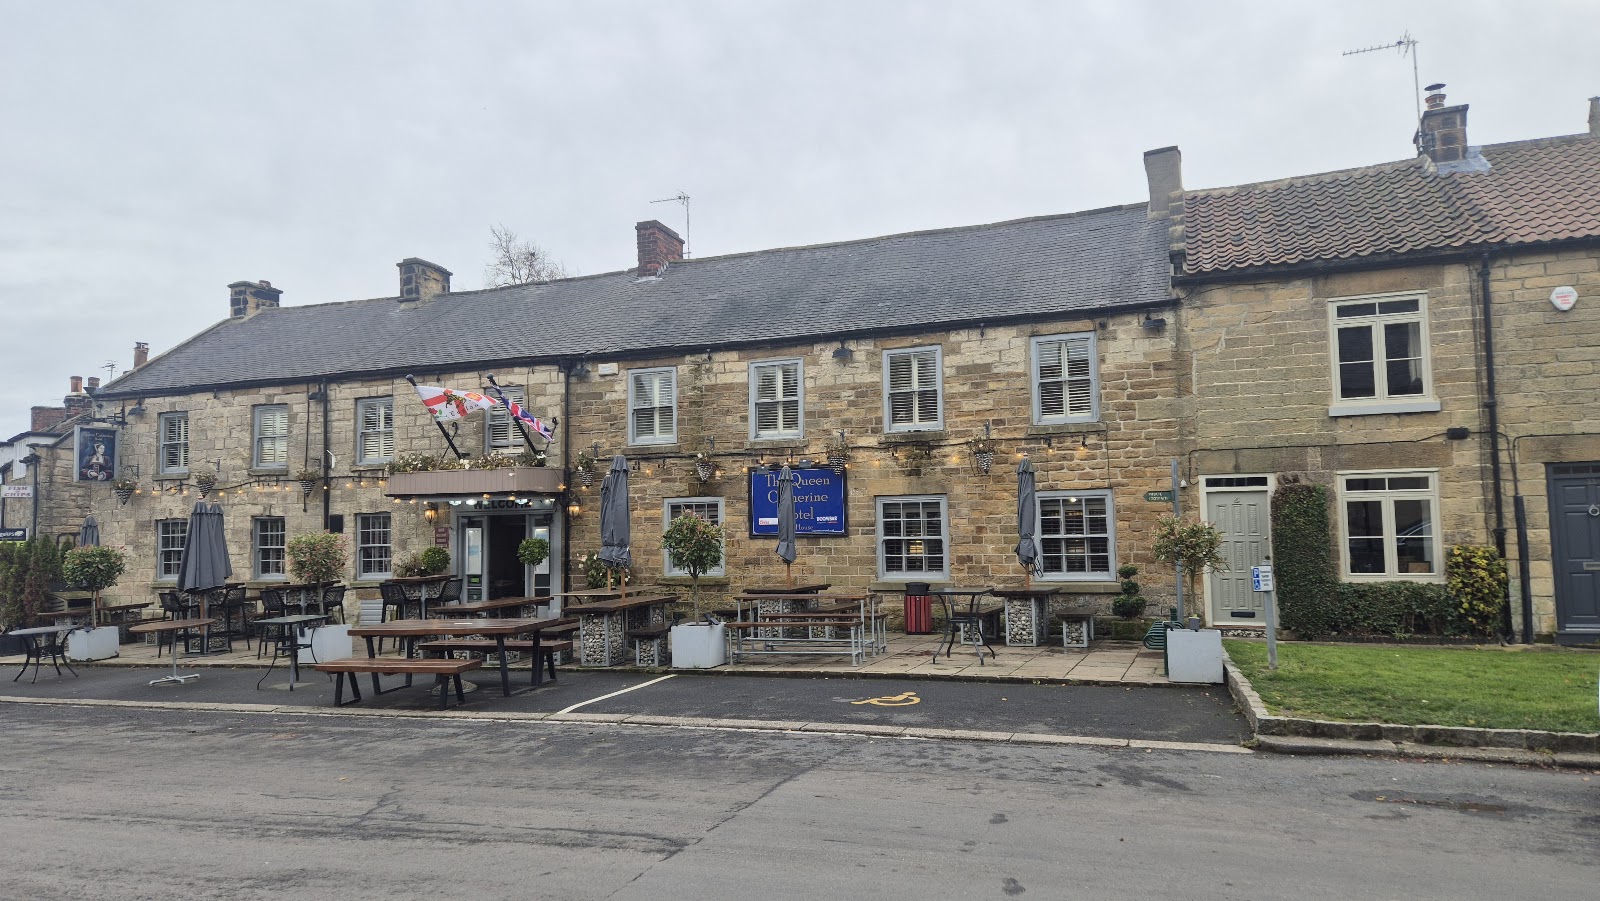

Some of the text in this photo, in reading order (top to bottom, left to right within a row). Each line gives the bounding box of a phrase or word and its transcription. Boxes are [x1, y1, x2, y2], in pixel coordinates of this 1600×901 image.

[791, 472, 830, 489] Queen
[767, 489, 829, 504] Cerine
[795, 506, 815, 520] tel
